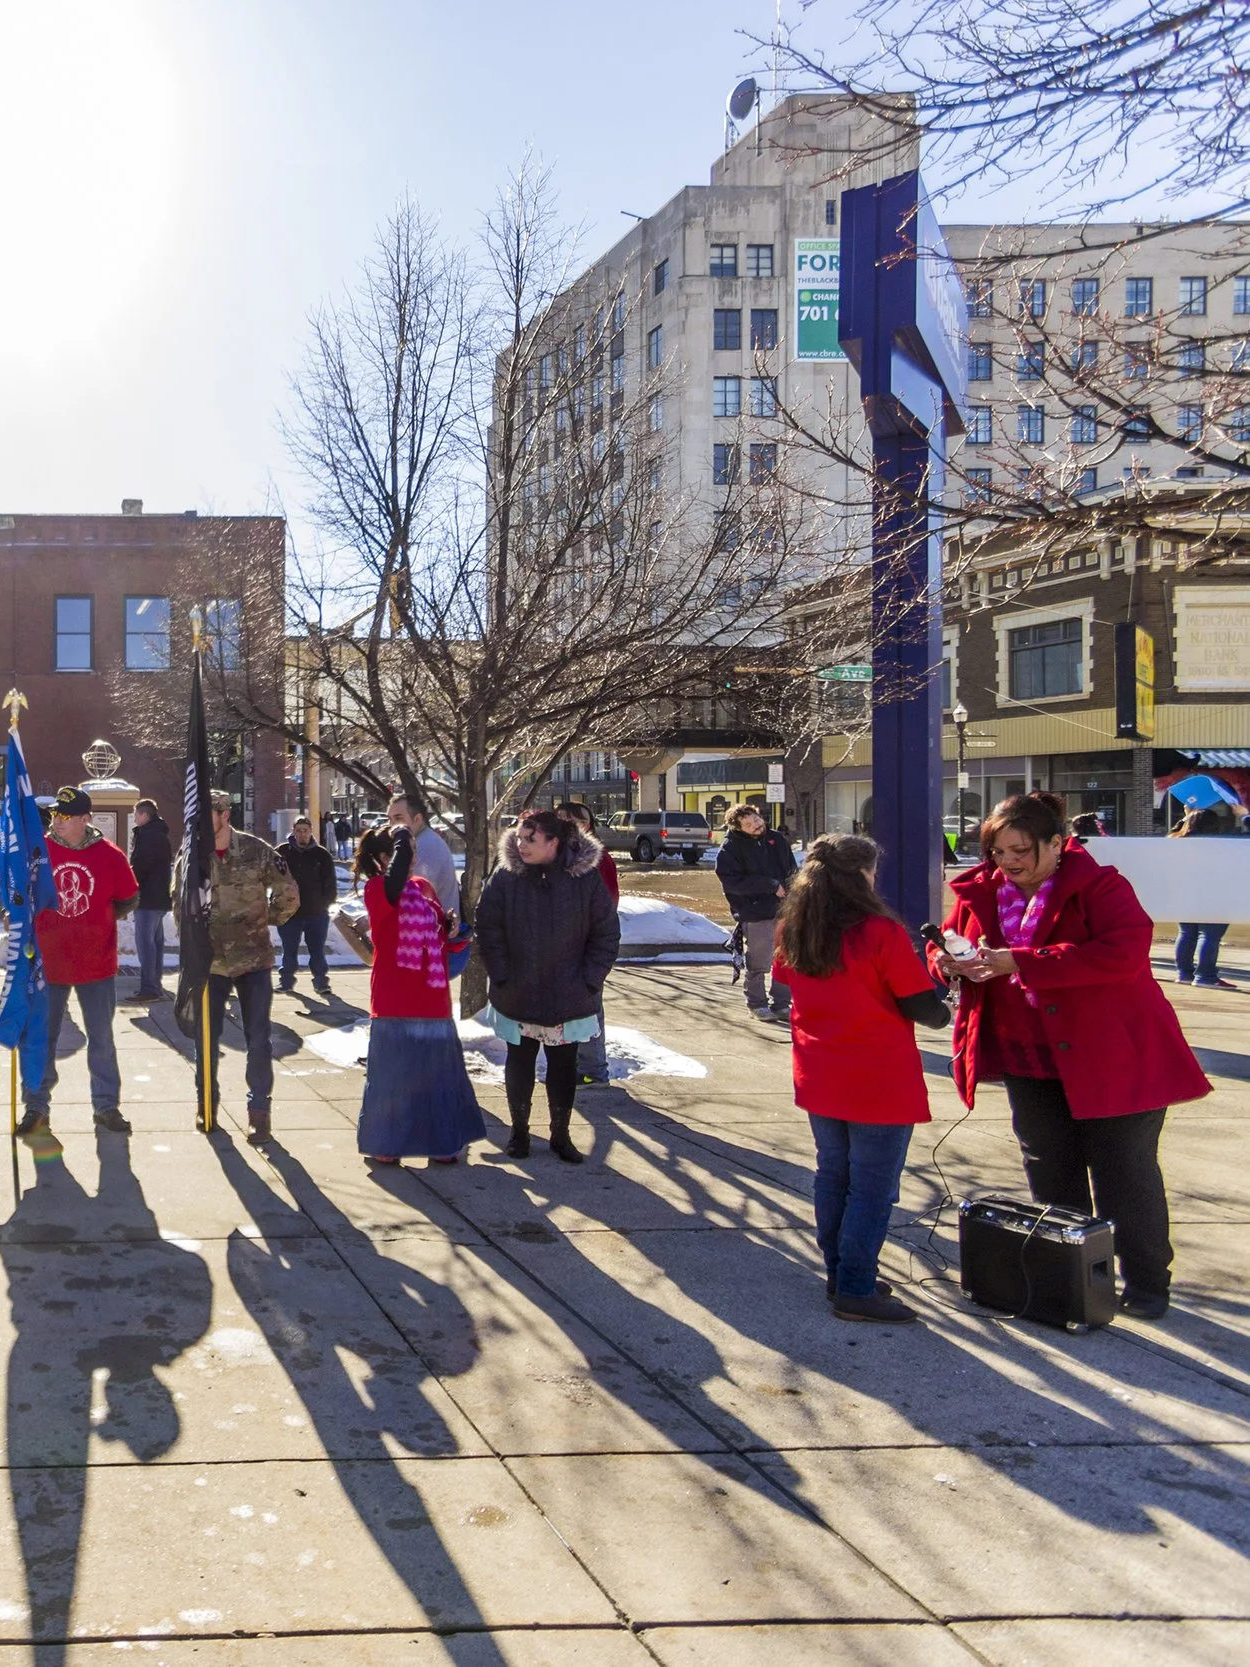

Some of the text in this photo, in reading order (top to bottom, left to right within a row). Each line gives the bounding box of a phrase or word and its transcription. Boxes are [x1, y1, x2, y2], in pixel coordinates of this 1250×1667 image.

[797, 254, 841, 272] FOR
[799, 305, 829, 321] 701
[1204, 648, 1239, 661] BANK
